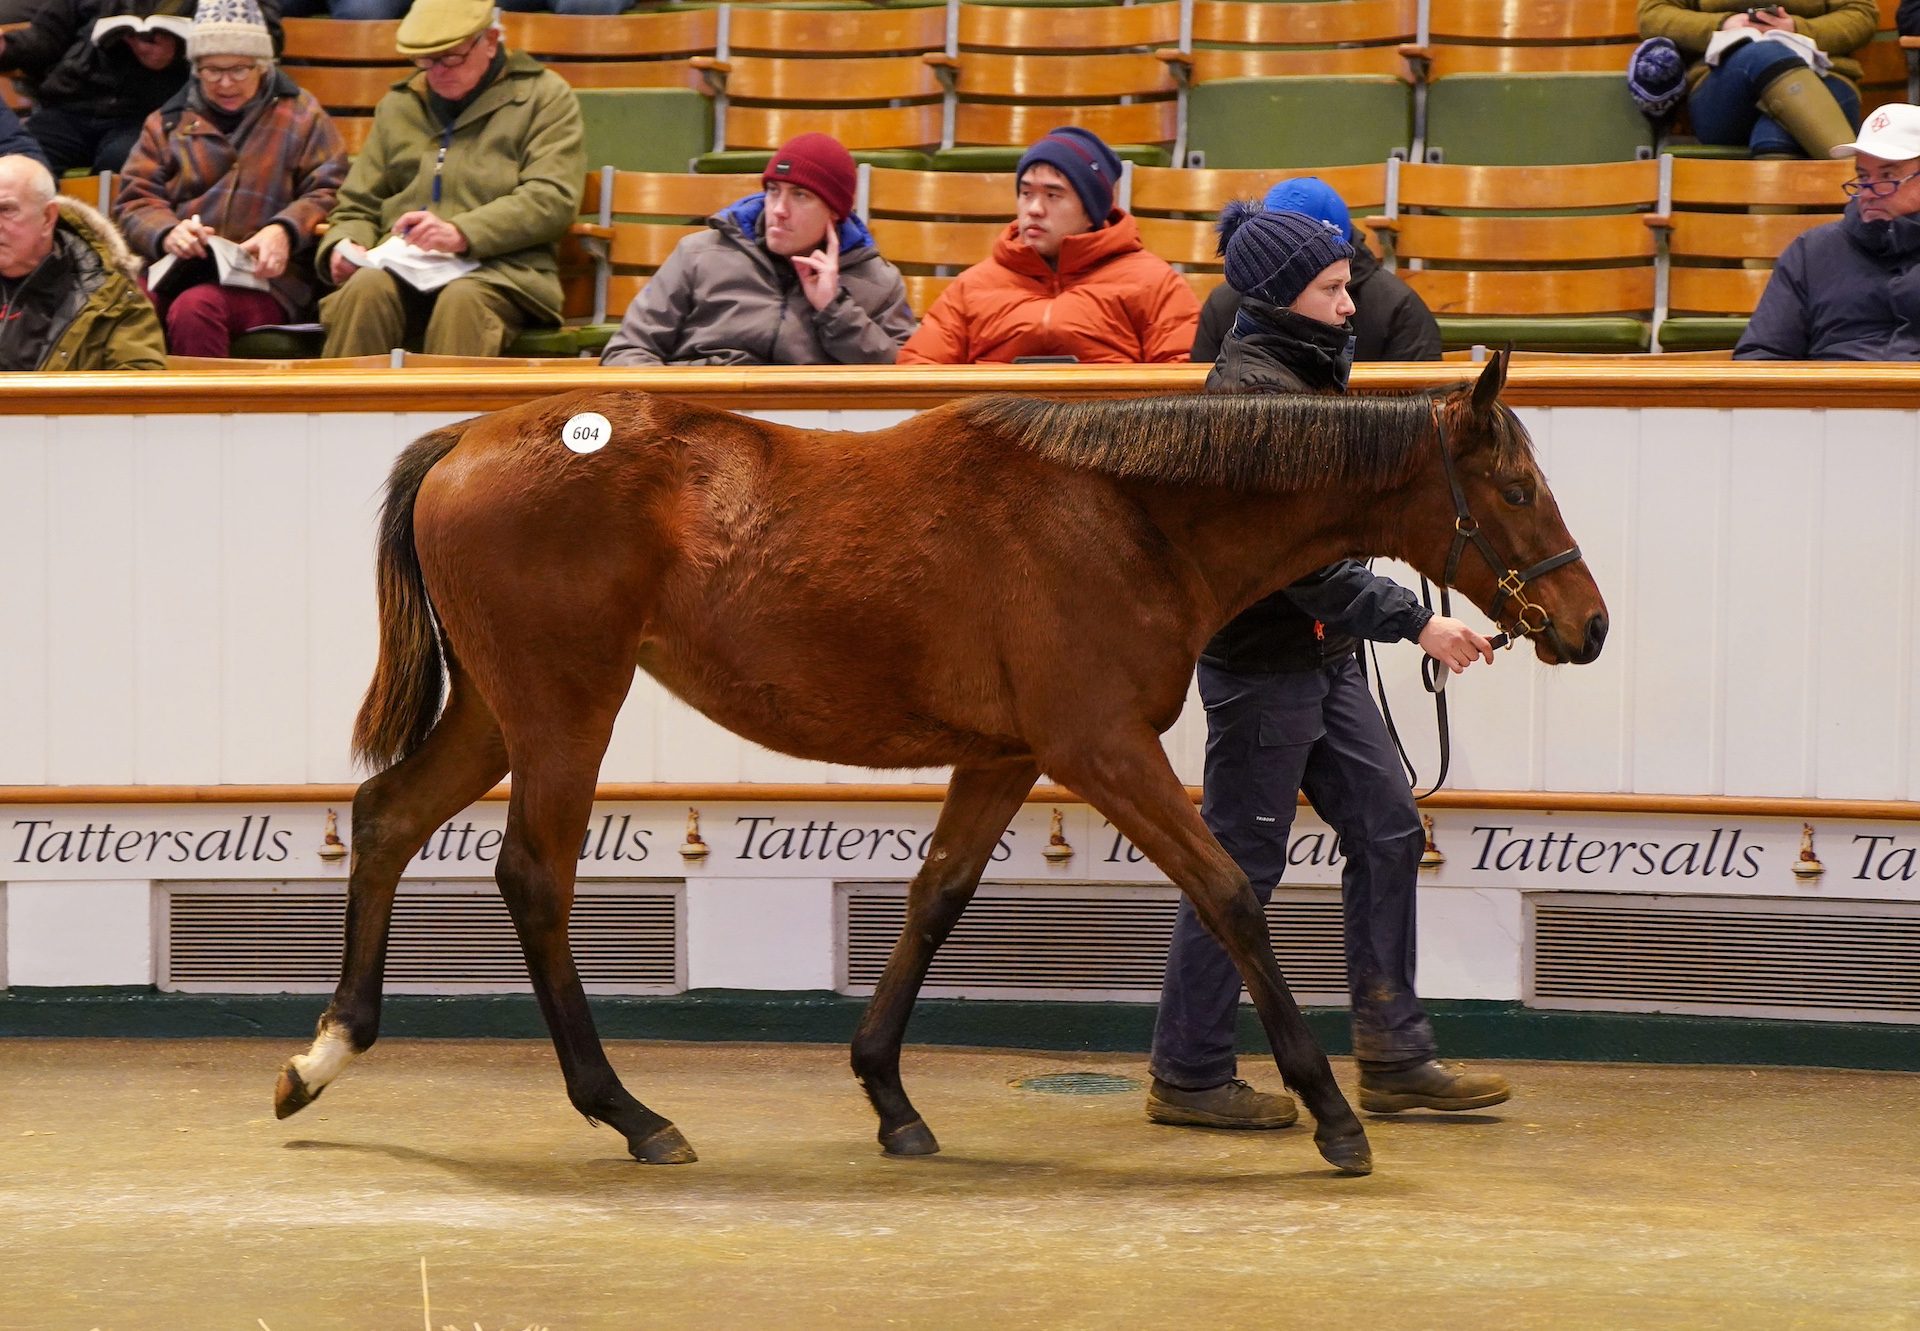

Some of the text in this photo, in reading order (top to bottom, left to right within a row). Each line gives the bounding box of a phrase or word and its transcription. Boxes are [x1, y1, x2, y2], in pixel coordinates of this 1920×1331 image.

[573, 427, 599, 441] 604
[12, 815, 292, 863] Tattersalls
[420, 814, 653, 862] ttells
[735, 816, 1016, 862] Tatterss
[1471, 826, 1764, 878] Tattersalls
